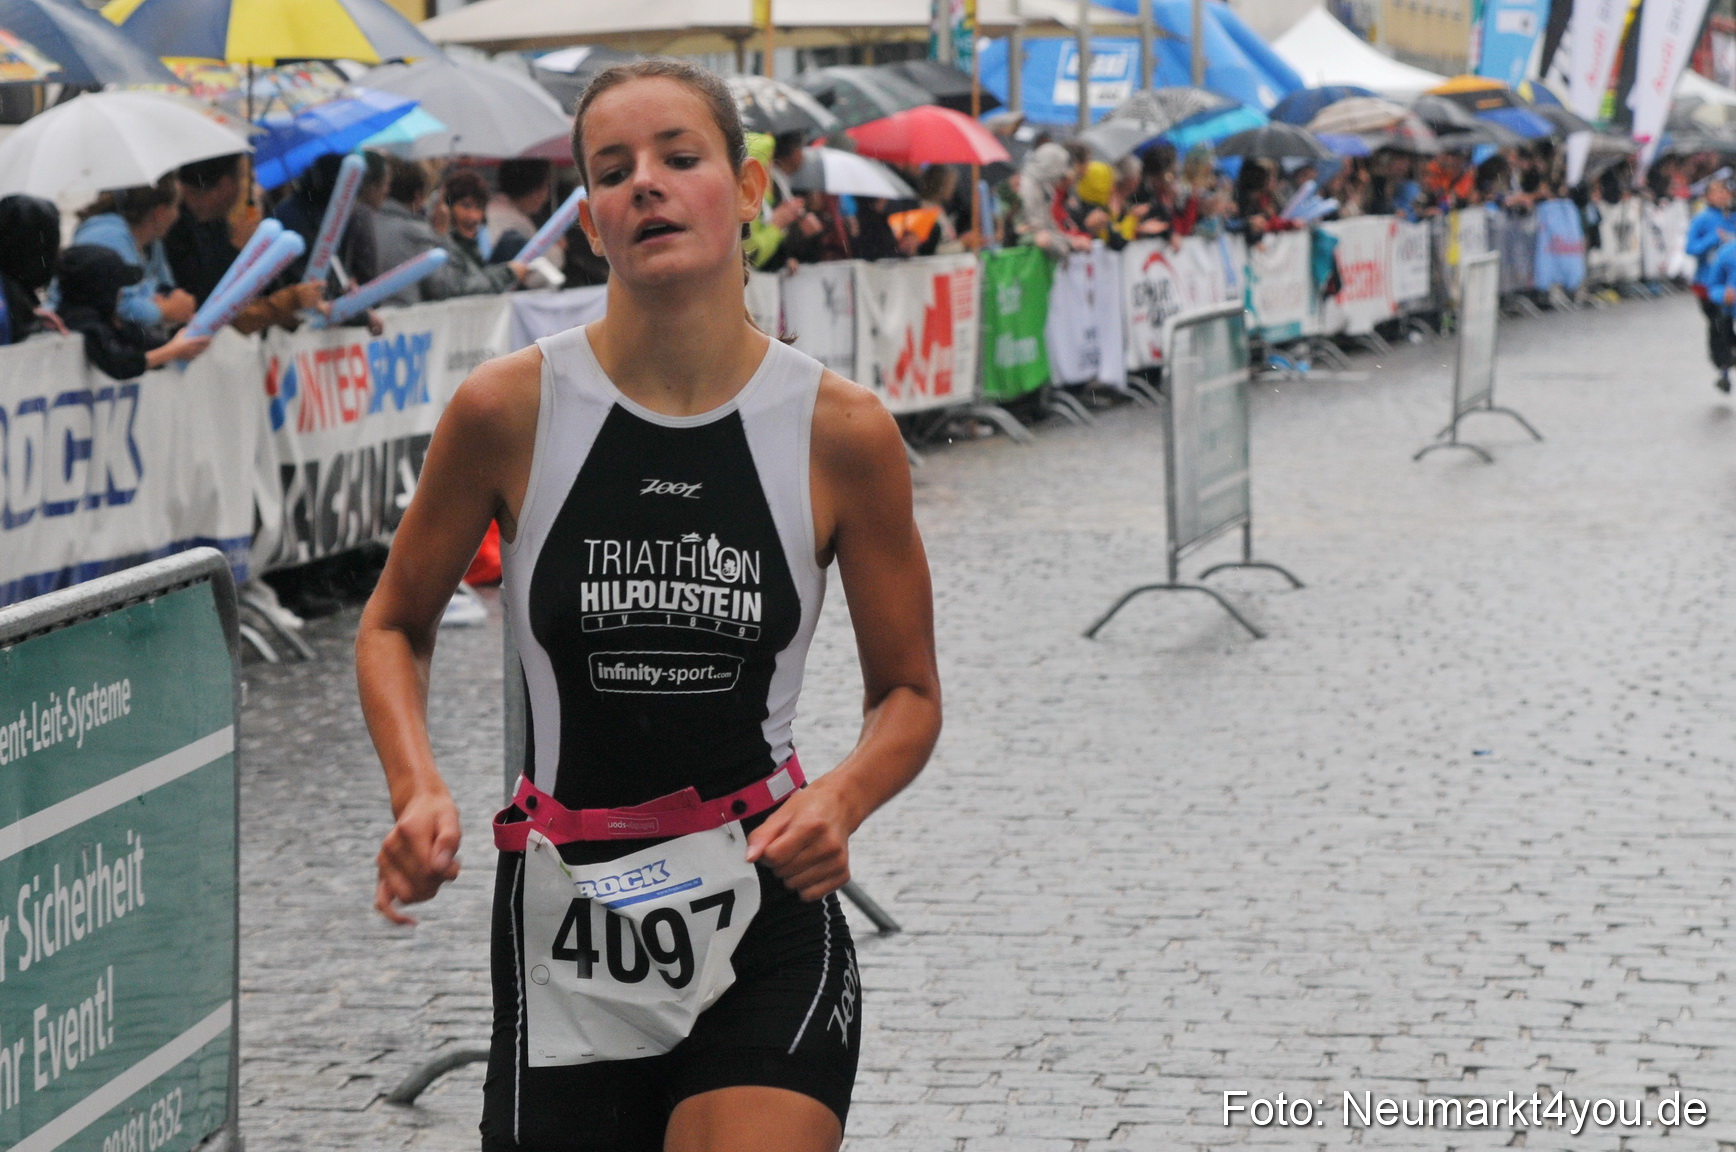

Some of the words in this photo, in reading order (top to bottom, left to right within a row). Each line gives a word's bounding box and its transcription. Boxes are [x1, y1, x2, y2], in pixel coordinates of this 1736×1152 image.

[583, 538, 761, 585] TRIATHLON
[580, 579, 762, 622] HILPOLTSTEIN
[665, 613, 746, 638] 1879
[17, 829, 146, 972] Sicherheit
[551, 888, 736, 990] 4097
[33, 964, 115, 1092] Event!
[149, 1086, 183, 1152] 6352
